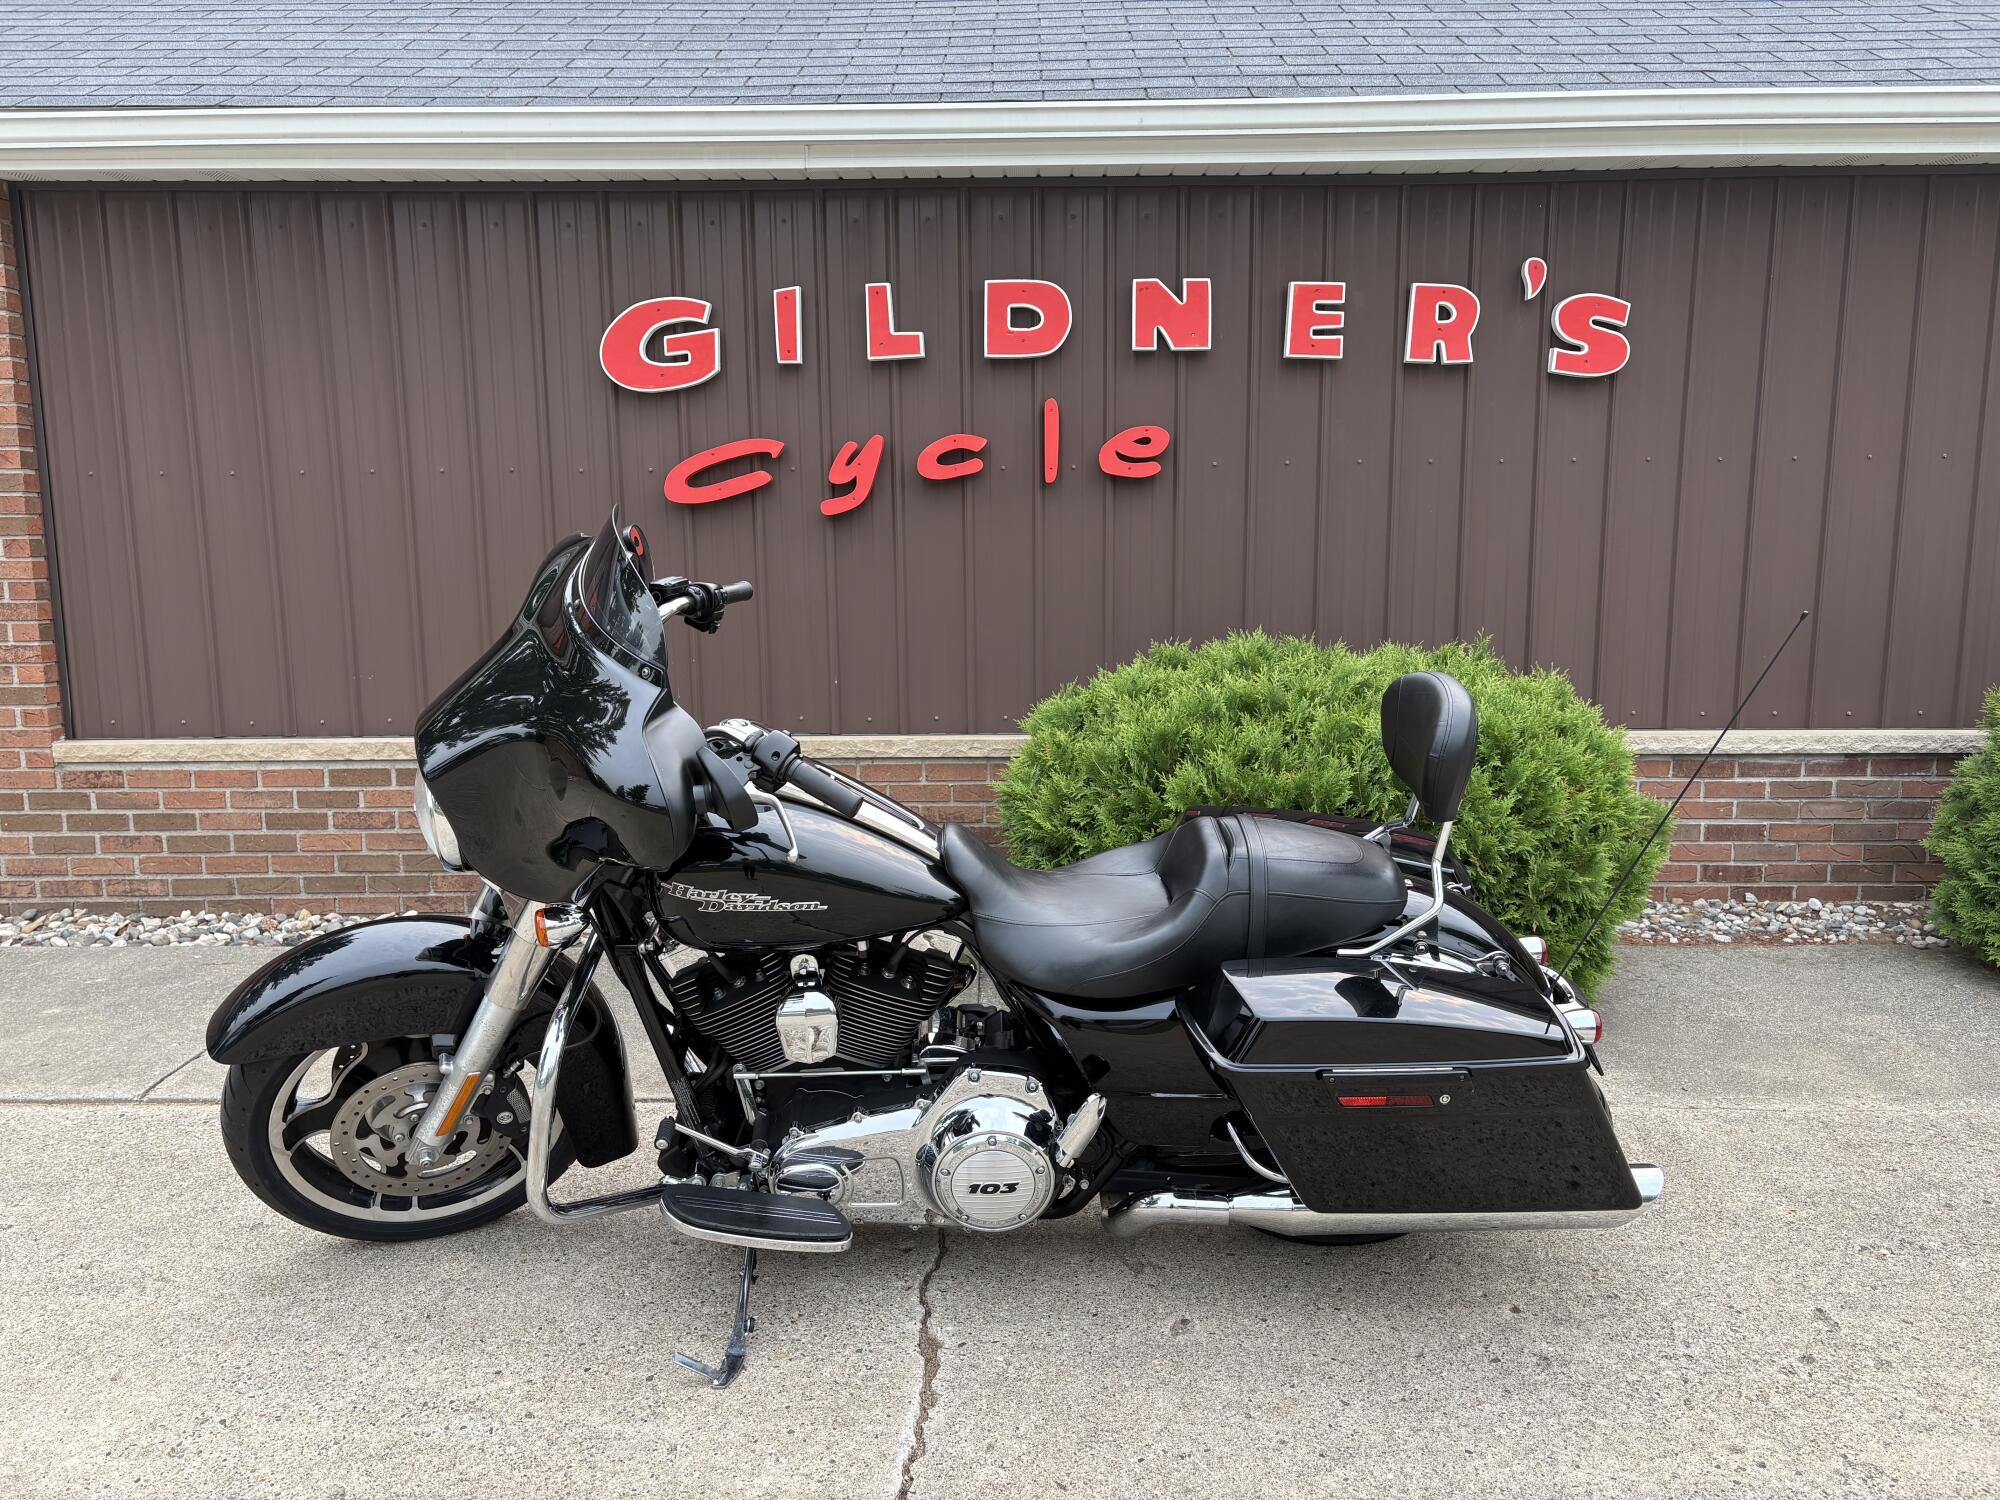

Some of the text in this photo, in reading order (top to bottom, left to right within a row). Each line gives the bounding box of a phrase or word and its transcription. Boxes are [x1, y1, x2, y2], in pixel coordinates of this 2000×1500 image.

[600, 257, 1631, 392] GILDNER'S
[698, 898, 828, 913] Davidson
[968, 1181, 1020, 1195] 103
